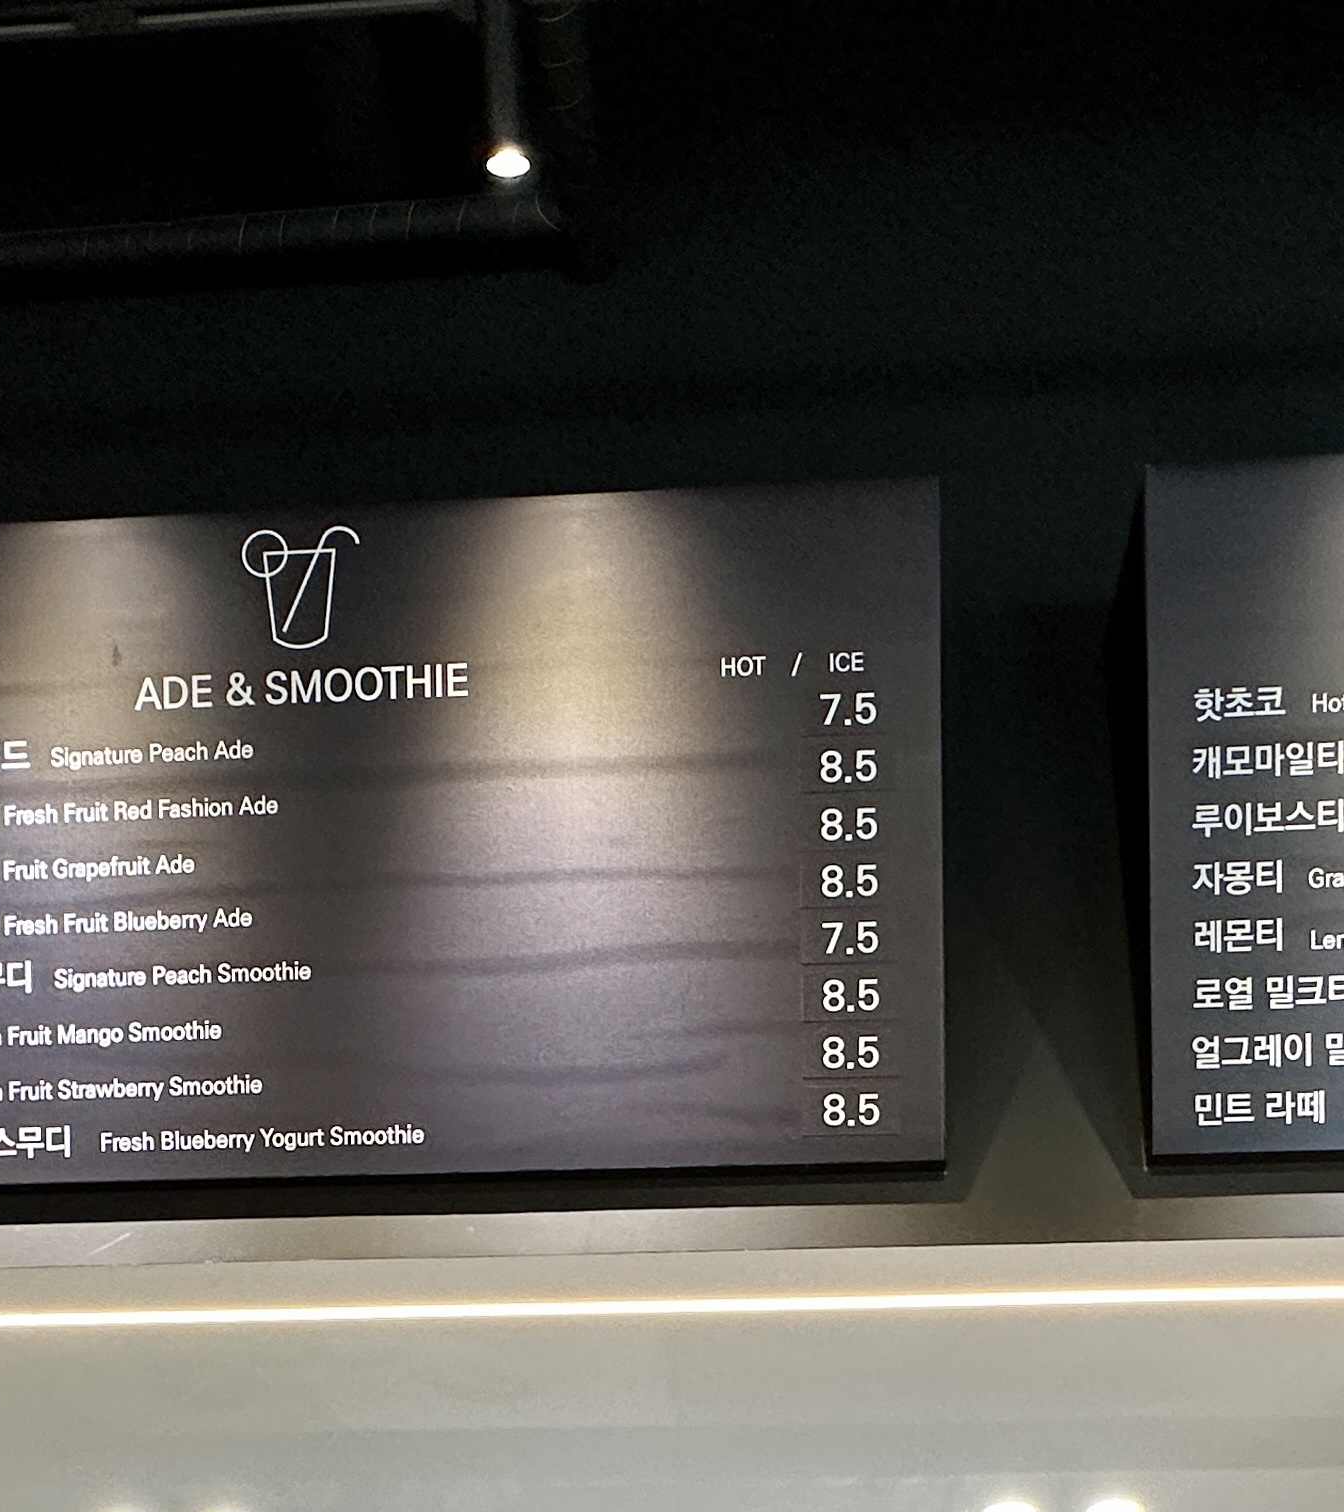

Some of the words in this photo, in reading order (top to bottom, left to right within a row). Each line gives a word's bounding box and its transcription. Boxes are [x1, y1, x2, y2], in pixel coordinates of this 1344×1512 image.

[721, 656, 766, 676] HOT
[830, 652, 864, 672] ICE
[135, 675, 212, 710] ADE
[226, 672, 255, 706] &
[266, 663, 468, 704] SMOOTHIE
[820, 693, 876, 725] 7.5
[1194, 687, 1285, 722] 핫초코
[51, 747, 143, 770] Signature
[150, 741, 208, 762] Peach
[214, 740, 253, 759] Ade
[821, 750, 876, 783] 8.5
[1193, 741, 1344, 779] 캐모마일티
[4, 803, 58, 825] Fresh
[64, 802, 109, 823] Fruit
[114, 800, 152, 821] Red
[159, 798, 233, 818] Fashion
[239, 795, 278, 815] Ade
[821, 808, 877, 841] 8.5
[1192, 799, 1344, 837] 루이보스티
[3, 859, 48, 881] Fruit
[52, 856, 151, 882] Grapefruit
[156, 854, 194, 874] Ade
[822, 865, 878, 897] 8.5
[1193, 860, 1282, 895] 자몽티
[4, 914, 58, 936] Fresh
[64, 913, 109, 933] Fruit
[114, 910, 207, 932] Blueberry
[213, 908, 252, 927] Ade
[822, 921, 878, 954] 7.5
[1195, 918, 1282, 953] 레몬티
[54, 969, 146, 992] Signature
[153, 964, 212, 985] Peach
[218, 961, 311, 982] Smoothie
[823, 979, 879, 1012] 8.5
[1193, 977, 1253, 1010] 로열
[8, 1025, 52, 1045] Fruit
[58, 1024, 124, 1047] Mango
[129, 1020, 221, 1042] Smoothie
[1192, 1033, 1312, 1069] 얼그레이
[9, 1080, 53, 1101] Fruit
[58, 1078, 164, 1101] Strawberry
[169, 1074, 262, 1096] Smoothie
[1195, 1093, 1255, 1125] 민트
[1266, 1090, 1324, 1124] 라떼
[101, 1132, 154, 1152] Fresh
[161, 1130, 255, 1152] Blueberry
[260, 1128, 324, 1150] Yogurt
[330, 1124, 424, 1145] Smoothie
